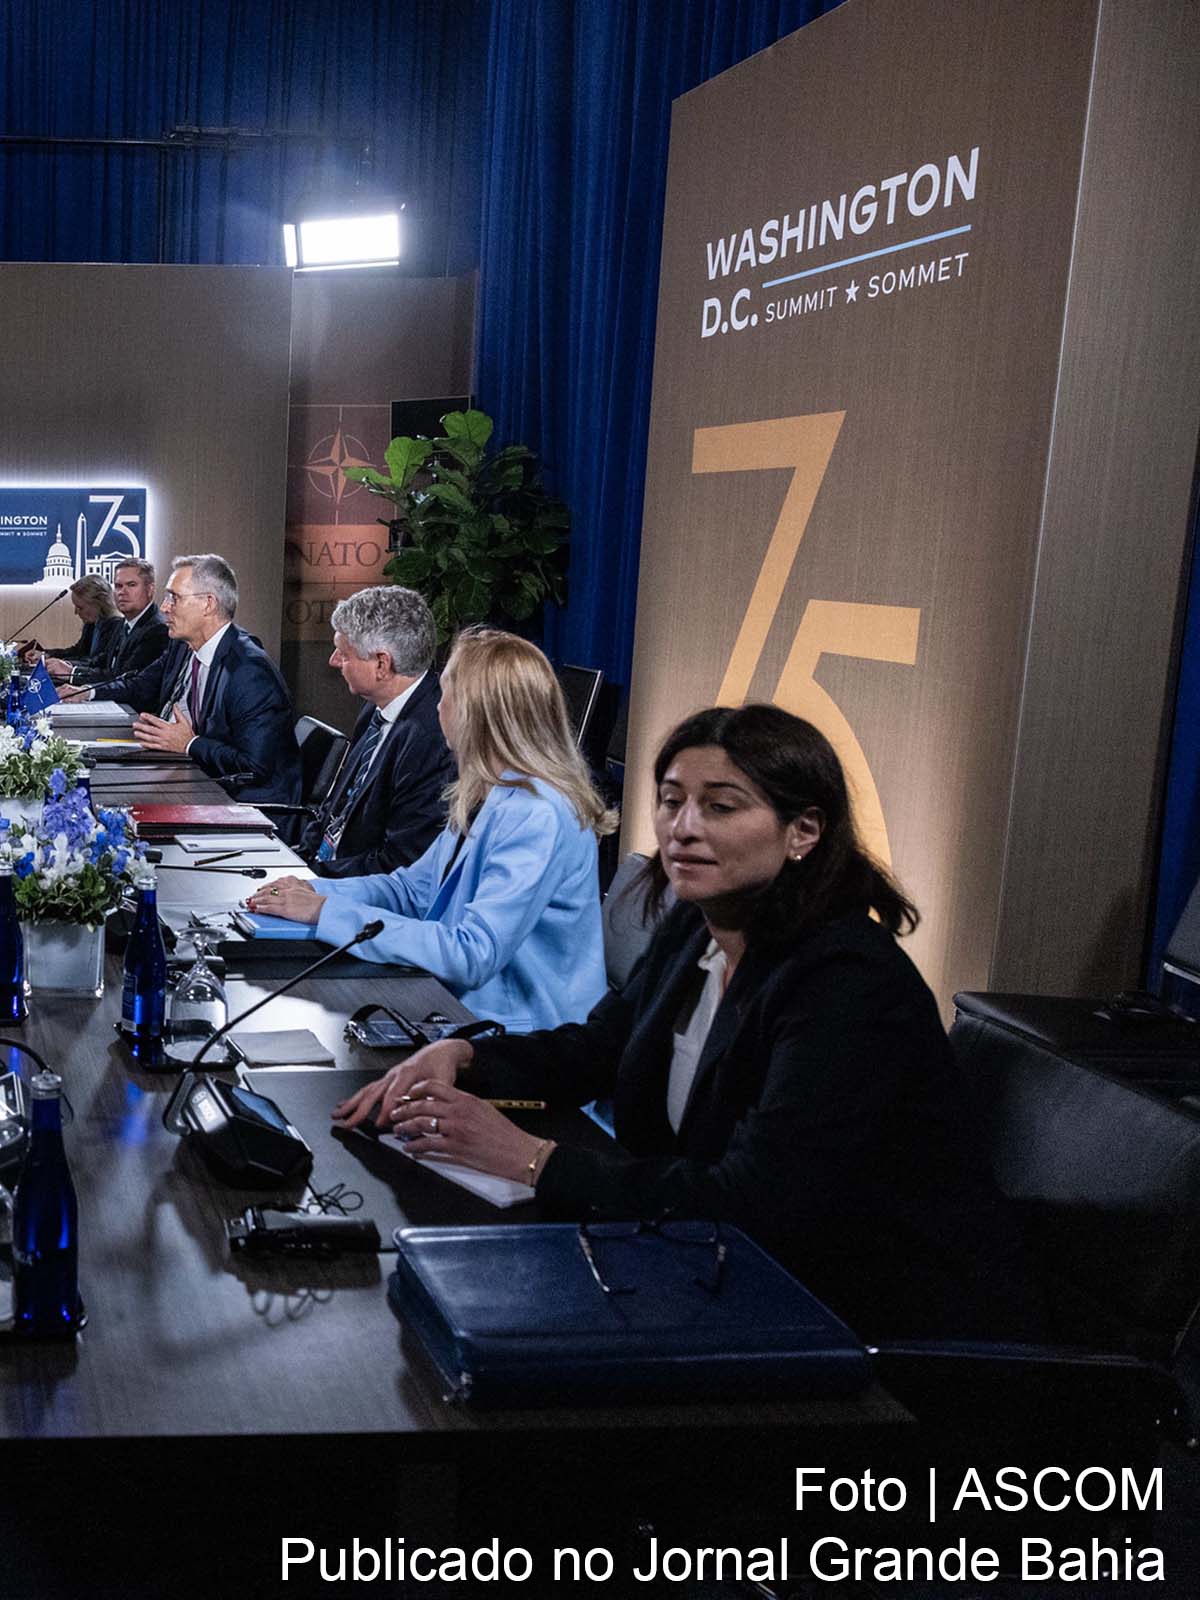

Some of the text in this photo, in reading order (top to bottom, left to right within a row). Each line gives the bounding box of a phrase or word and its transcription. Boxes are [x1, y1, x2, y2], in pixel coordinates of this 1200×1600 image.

[706, 146, 980, 280] WASHINGTON
[701, 252, 970, 338] D.C. SUMMIT SOMMET
[89, 495, 140, 558] 75
[287, 541, 382, 567] NATO
[285, 599, 334, 625] OT
